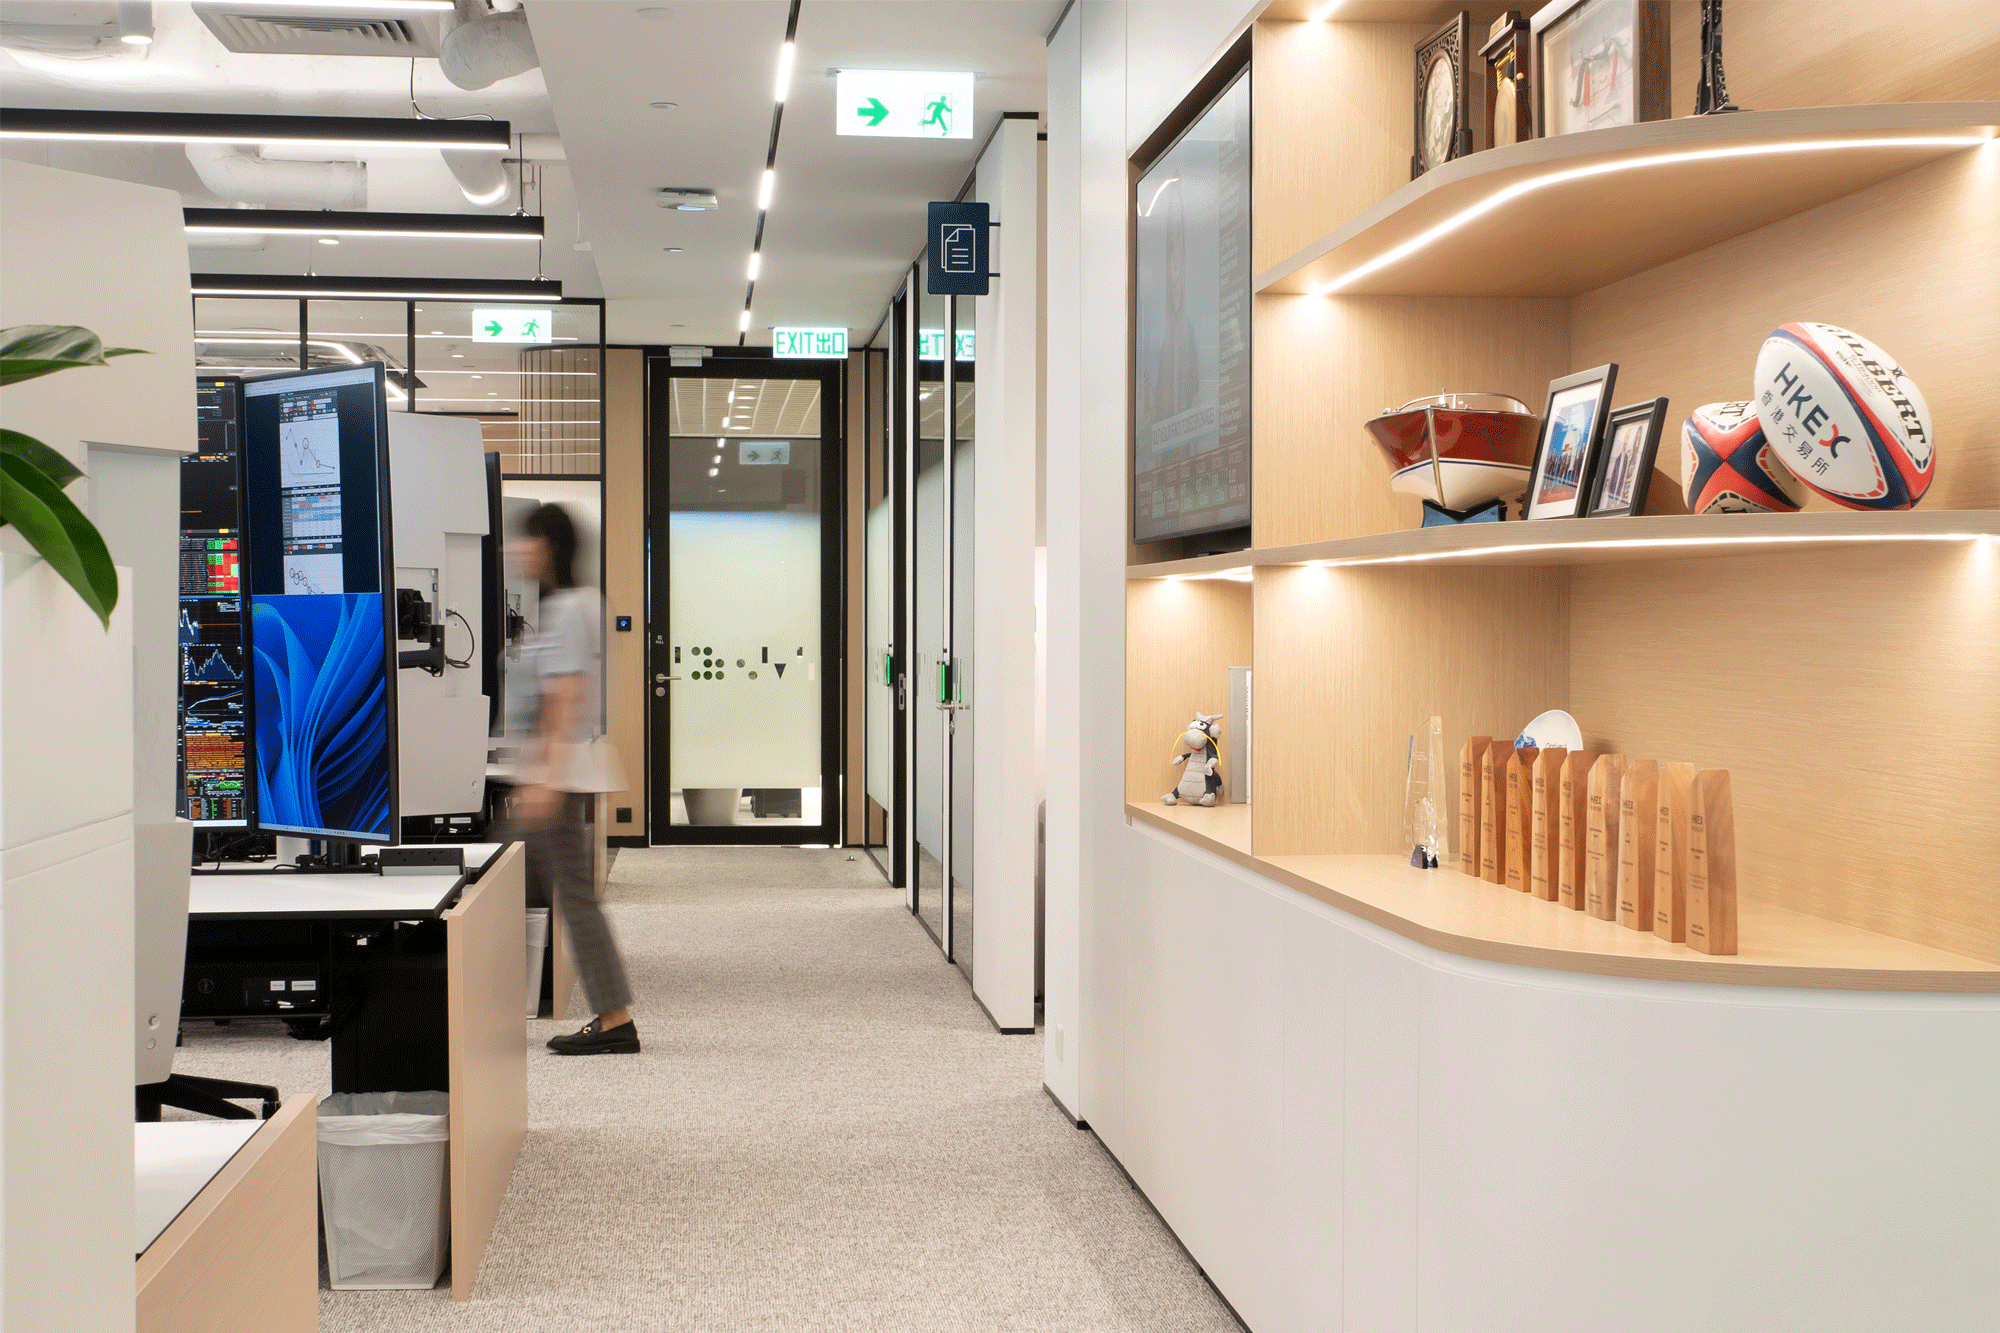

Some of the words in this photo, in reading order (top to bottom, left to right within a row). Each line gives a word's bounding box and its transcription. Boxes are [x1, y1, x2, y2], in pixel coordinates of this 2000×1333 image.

[776, 332, 814, 354] EXIT
[816, 332, 845, 354] 出口
[1761, 389, 1830, 476] 香港交易所
[1774, 362, 1851, 459] HKEX
